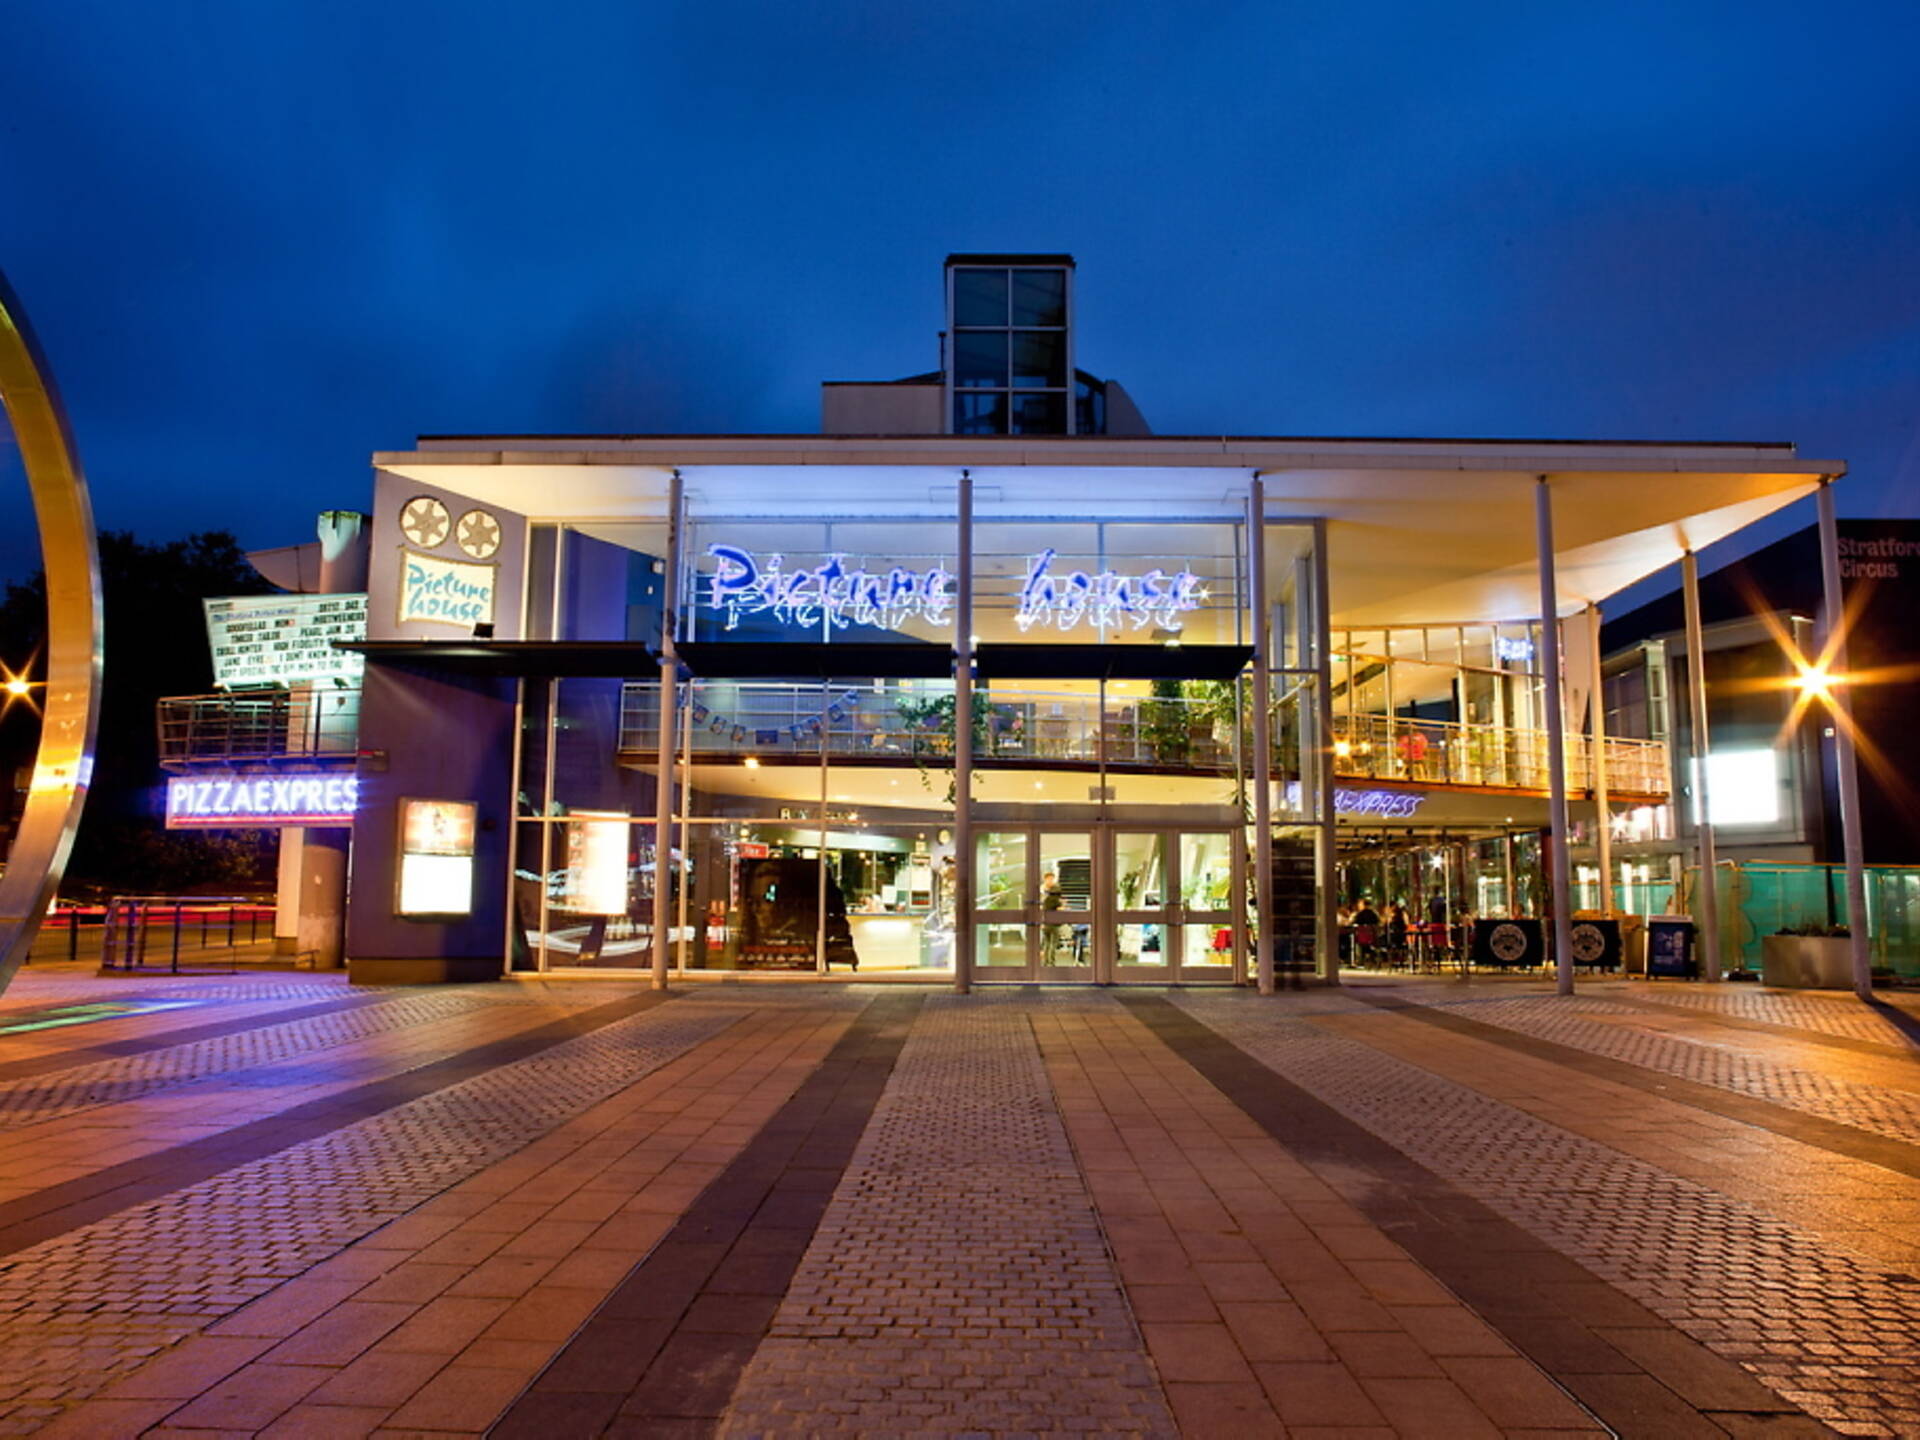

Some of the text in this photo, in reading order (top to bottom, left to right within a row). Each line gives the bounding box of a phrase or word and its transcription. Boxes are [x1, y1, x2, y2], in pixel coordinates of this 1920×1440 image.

[407, 563, 490, 602] Picture
[709, 543, 1197, 613] Picture house
[1840, 558, 1899, 578] Circus
[407, 587, 483, 619] house
[173, 777, 359, 813] PIZZAEXPRES
